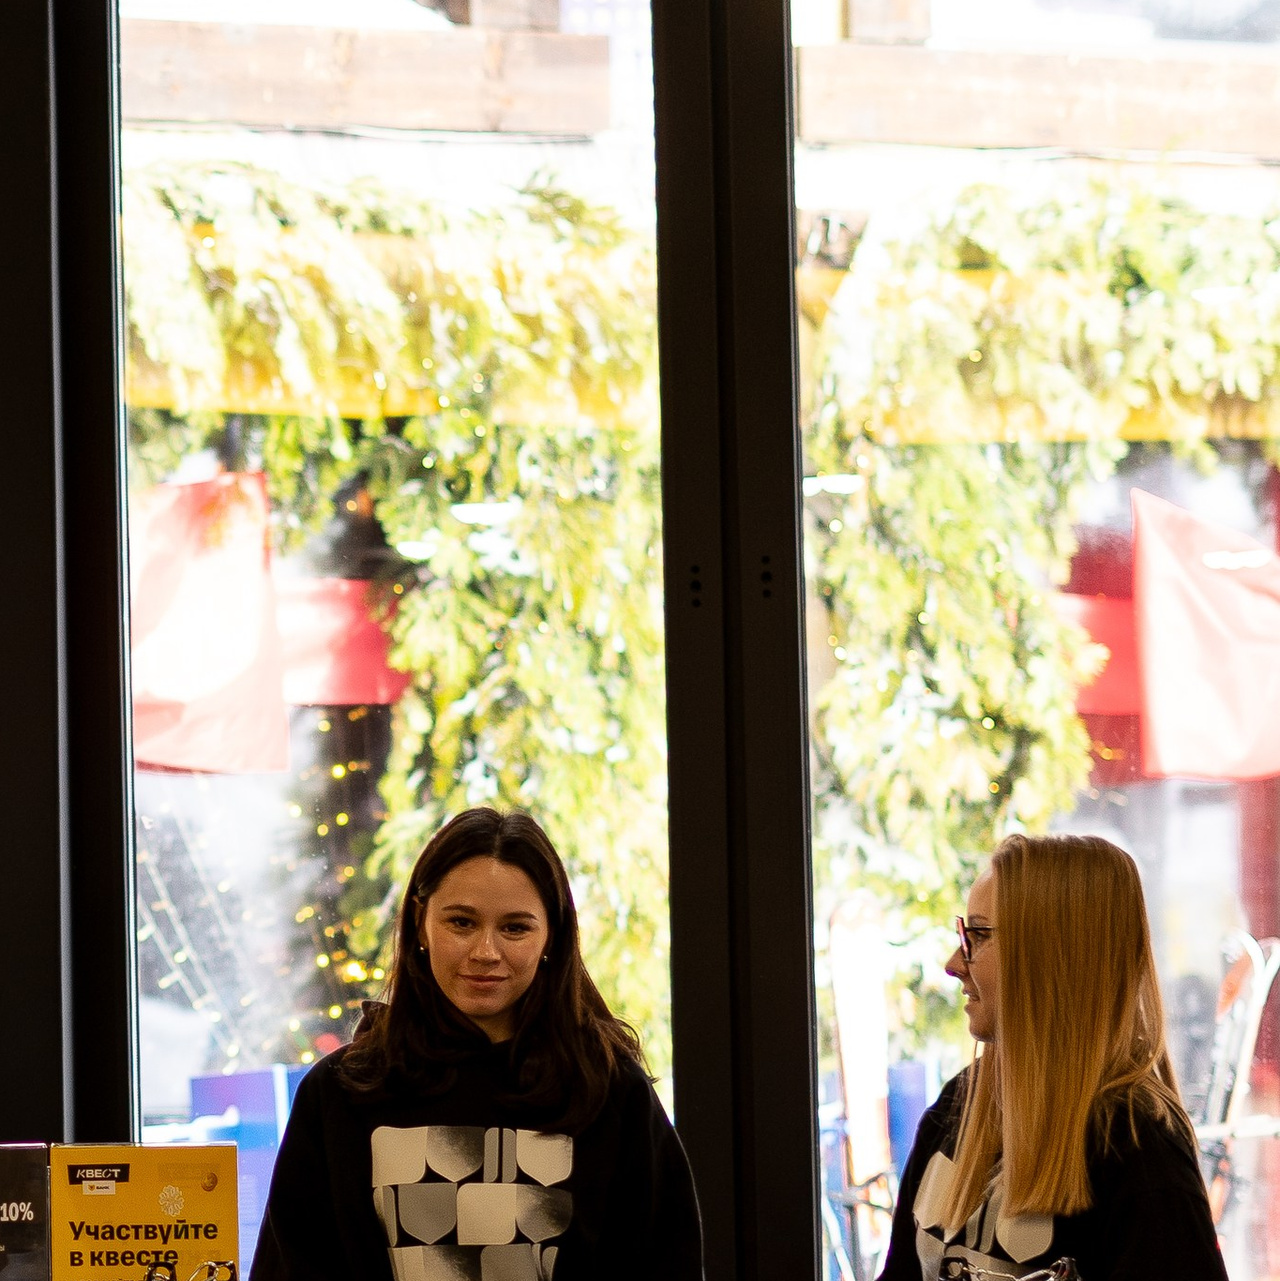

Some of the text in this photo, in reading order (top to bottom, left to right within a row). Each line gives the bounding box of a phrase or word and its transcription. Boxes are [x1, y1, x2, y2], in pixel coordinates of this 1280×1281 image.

[76, 1168, 121, 1179] КВЕСТ
[0, 1202, 34, 1222] 10%
[69, 1219, 218, 1245] Участвуйте
[70, 1250, 179, 1266] в квесте
